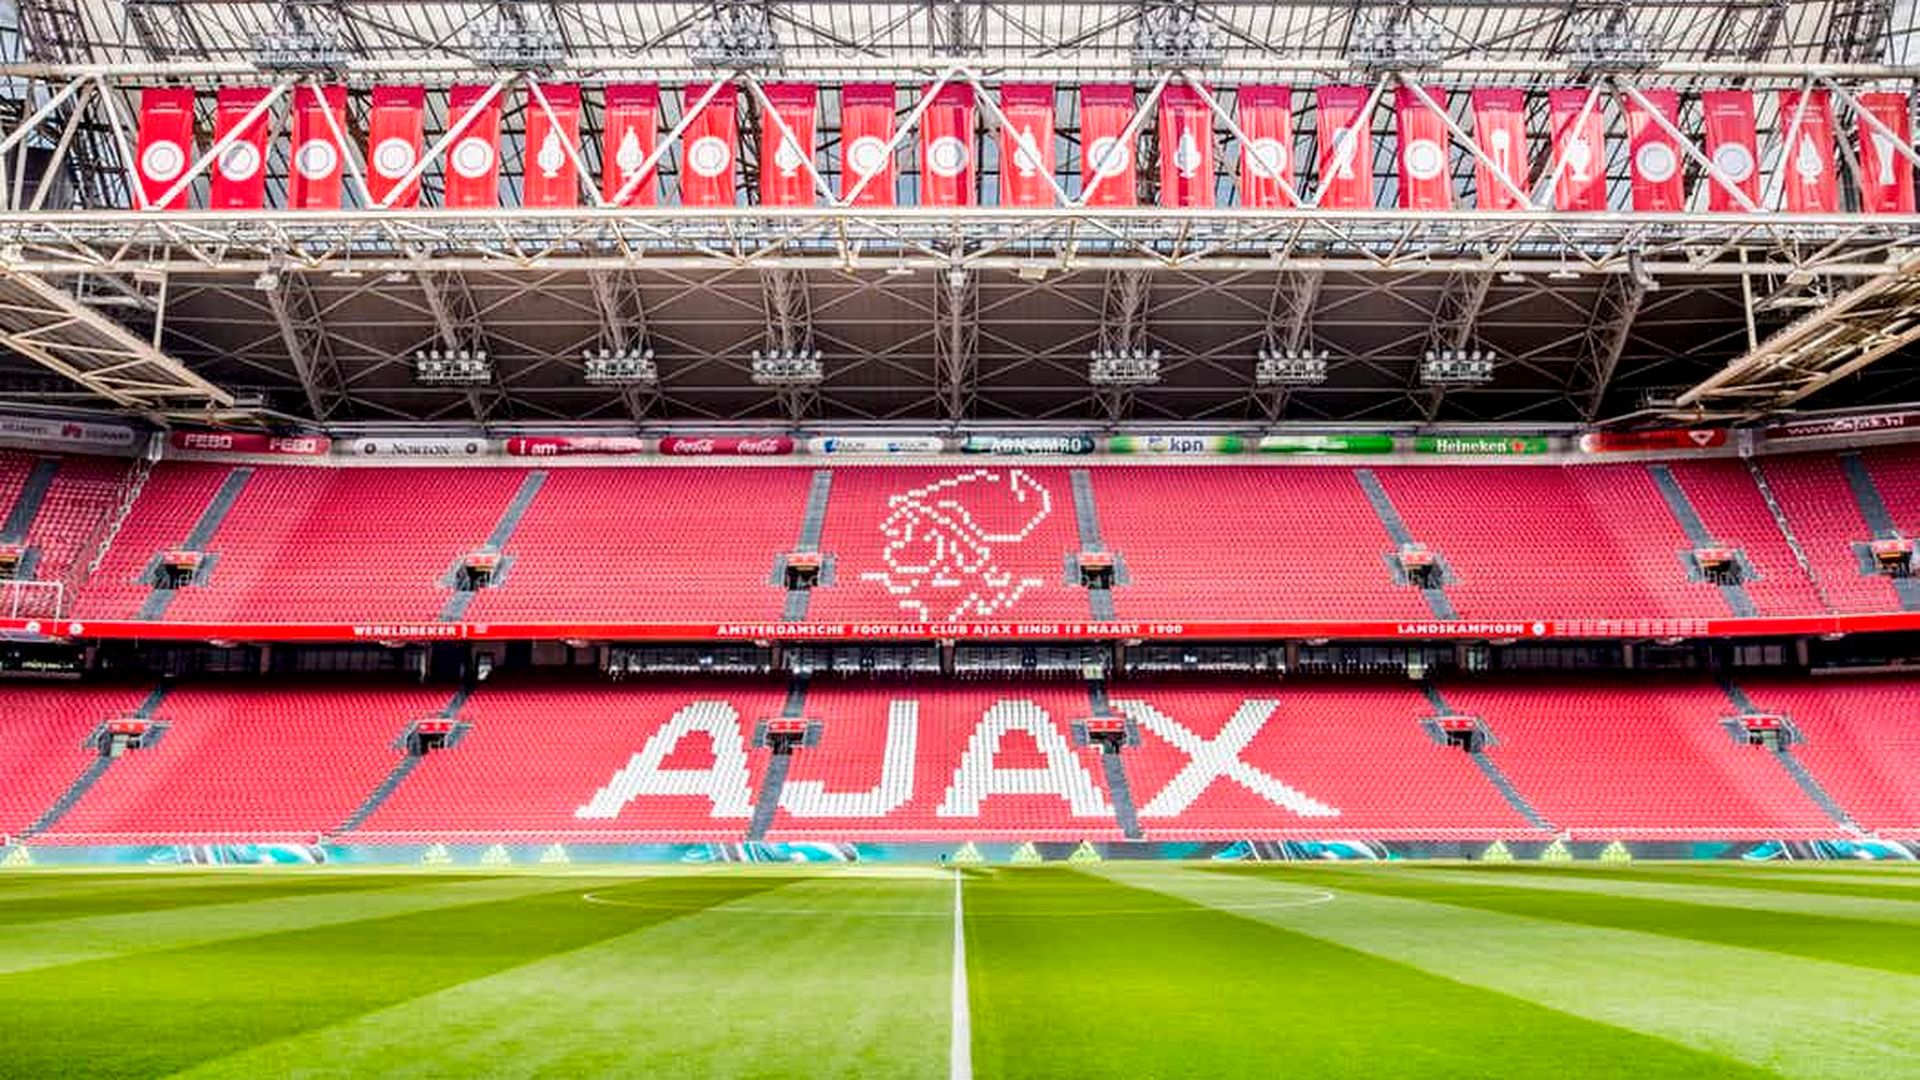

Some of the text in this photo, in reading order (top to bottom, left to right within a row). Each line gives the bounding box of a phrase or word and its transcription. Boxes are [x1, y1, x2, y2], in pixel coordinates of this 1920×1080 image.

[184, 433, 233, 448] FEBO
[269, 437, 317, 453] FEBO
[1168, 435, 1205, 455] kpn
[1435, 438, 1508, 453] Heineken
[353, 624, 456, 636] WERELDBEKER
[853, 623, 925, 635] FOOTBALL
[930, 623, 968, 635] CLUB
[973, 623, 1011, 636] AJAX
[1017, 623, 1059, 635] SINDS
[1066, 623, 1081, 634] 18
[1087, 623, 1140, 635] MAART
[1149, 623, 1183, 634] 1900
[1397, 623, 1525, 634] LANDSKAMPIOEN
[574, 699, 1342, 818] AJAX
